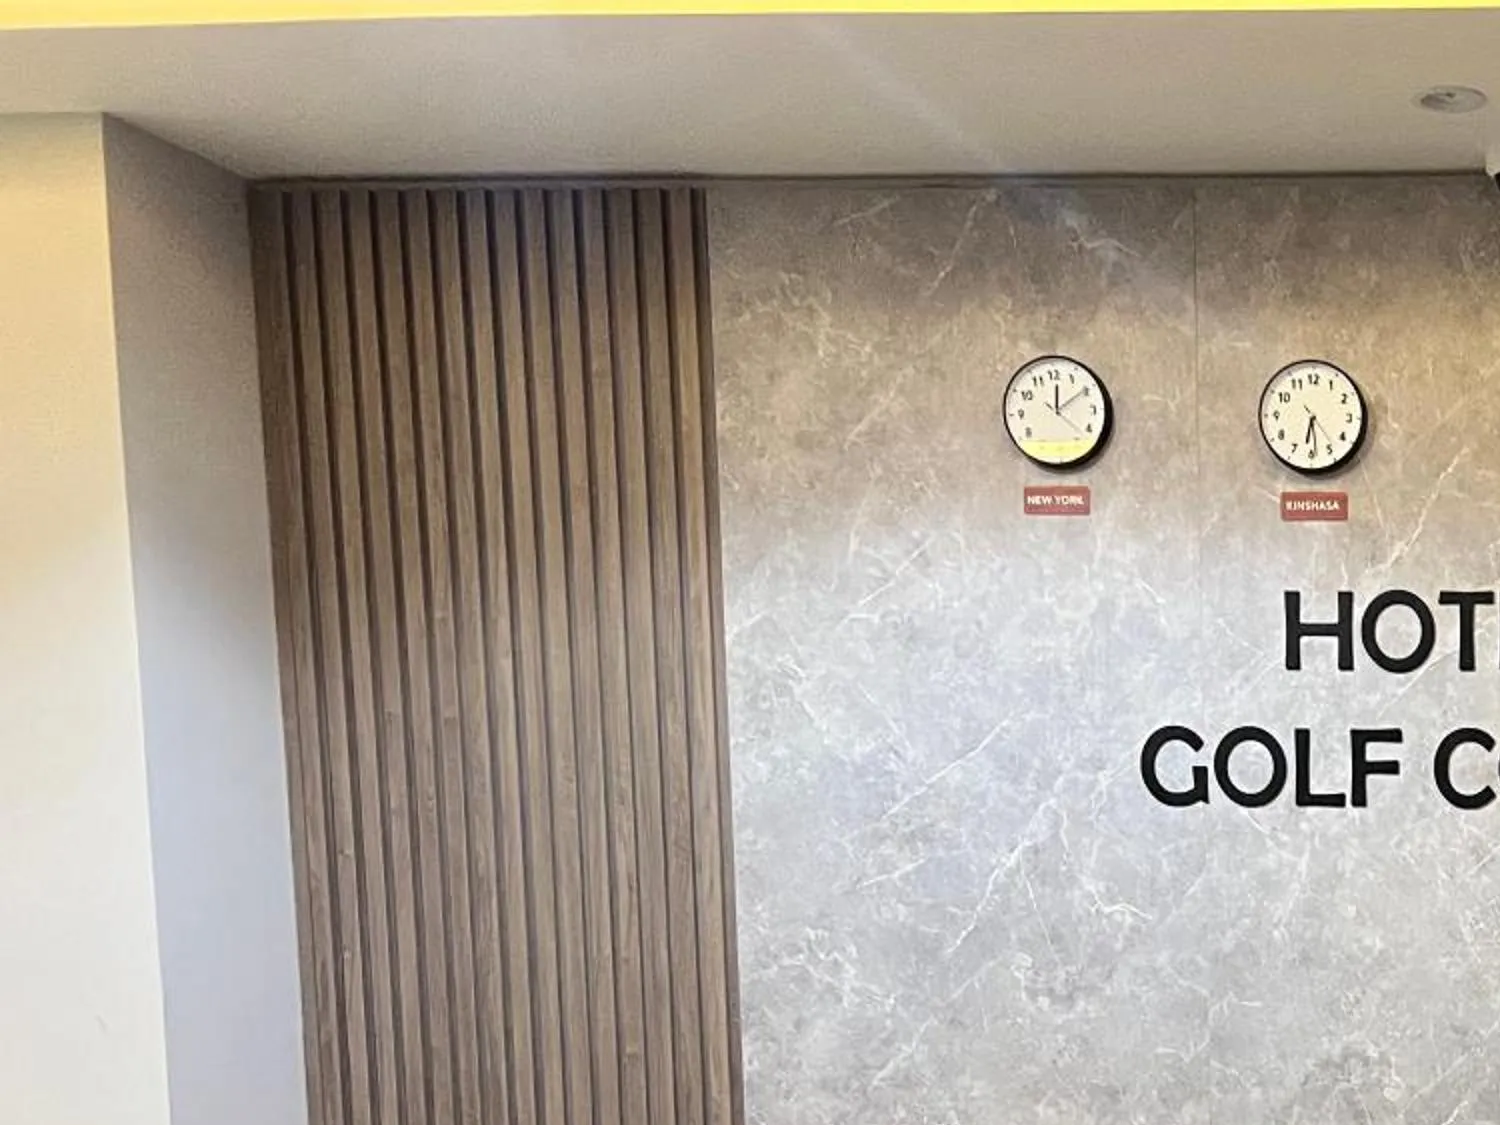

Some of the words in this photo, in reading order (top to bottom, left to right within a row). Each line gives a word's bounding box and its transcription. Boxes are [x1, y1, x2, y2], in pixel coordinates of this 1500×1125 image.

[1291, 379, 1302, 390] 11
[1308, 374, 1320, 385] 12
[1279, 392, 1290, 403] 10
[1341, 393, 1348, 404] 2
[1273, 411, 1280, 420] 9
[1292, 443, 1298, 453] 7
[1326, 444, 1332, 454] 5
[1027, 495, 1052, 505] NEW
[1053, 495, 1084, 505] YORK
[1286, 500, 1340, 511] KINSHASA
[1140, 725, 1402, 808] GOLF
